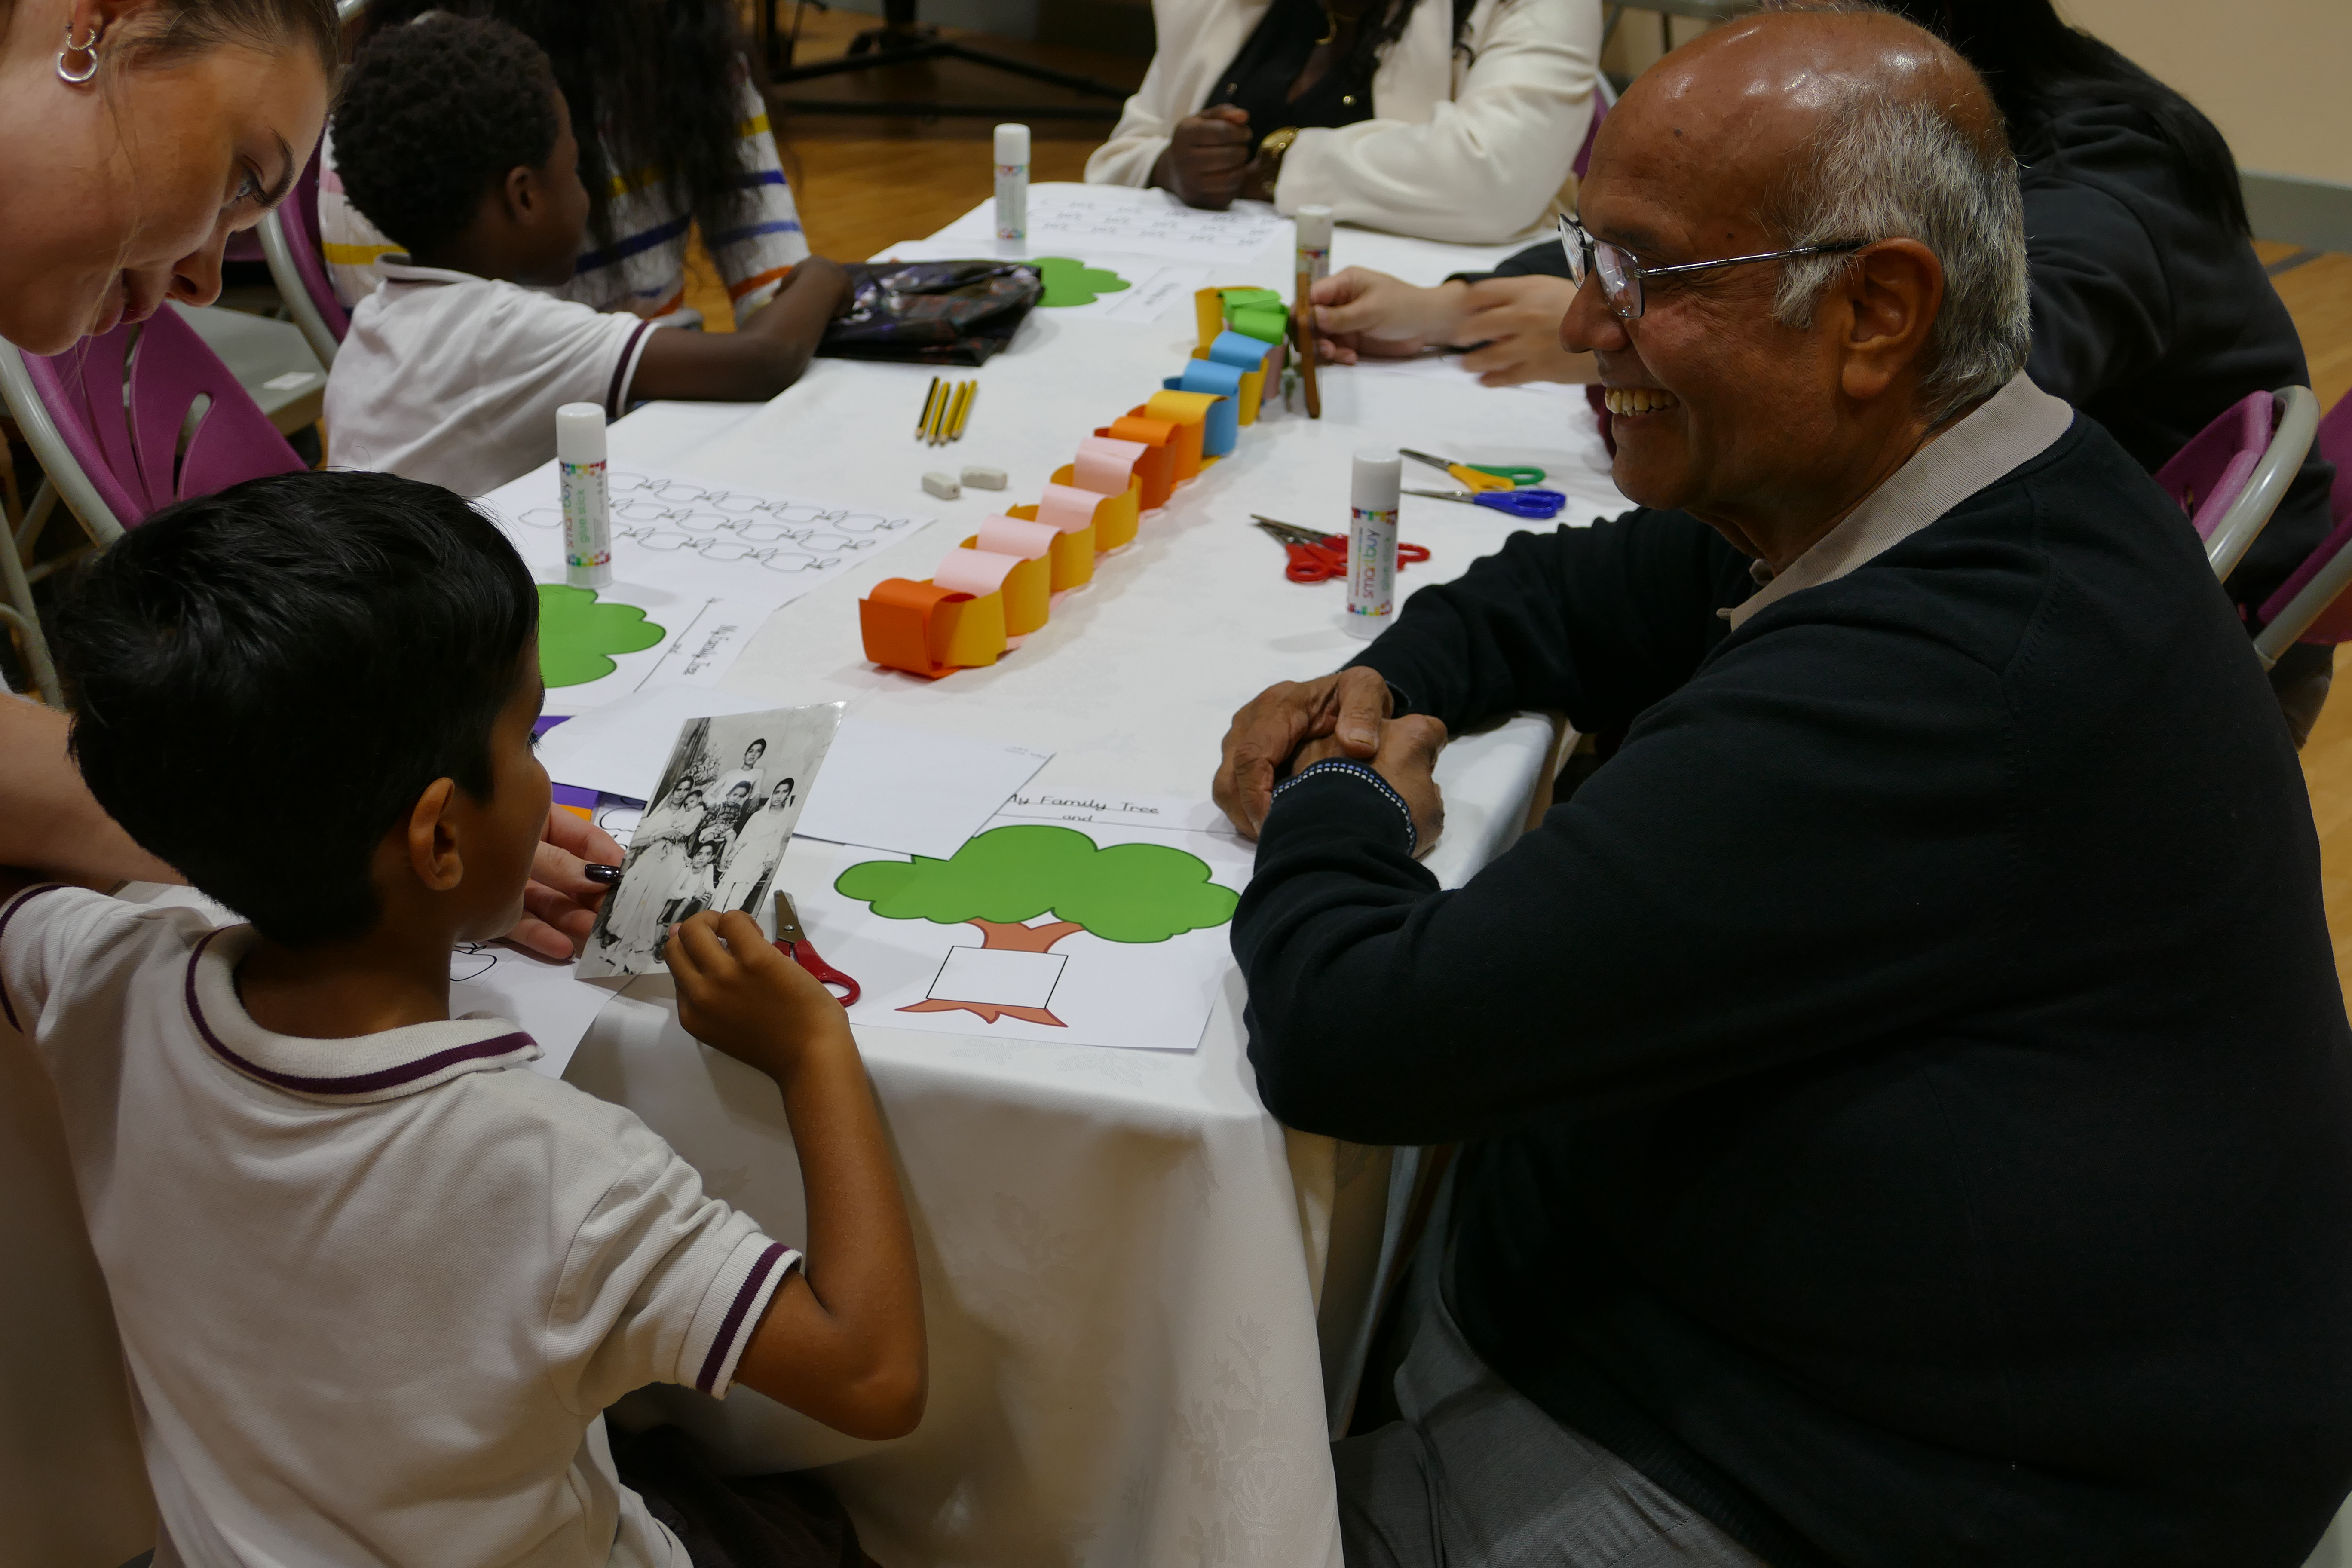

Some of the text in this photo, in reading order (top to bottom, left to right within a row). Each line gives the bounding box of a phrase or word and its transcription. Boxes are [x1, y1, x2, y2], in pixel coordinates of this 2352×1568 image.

[577, 489, 590, 543] glue stick
[1363, 529, 1380, 599] smartbuy
[691, 635, 729, 659] Family
[1039, 796, 1106, 812] Family
[1120, 801, 1160, 814] Tree
